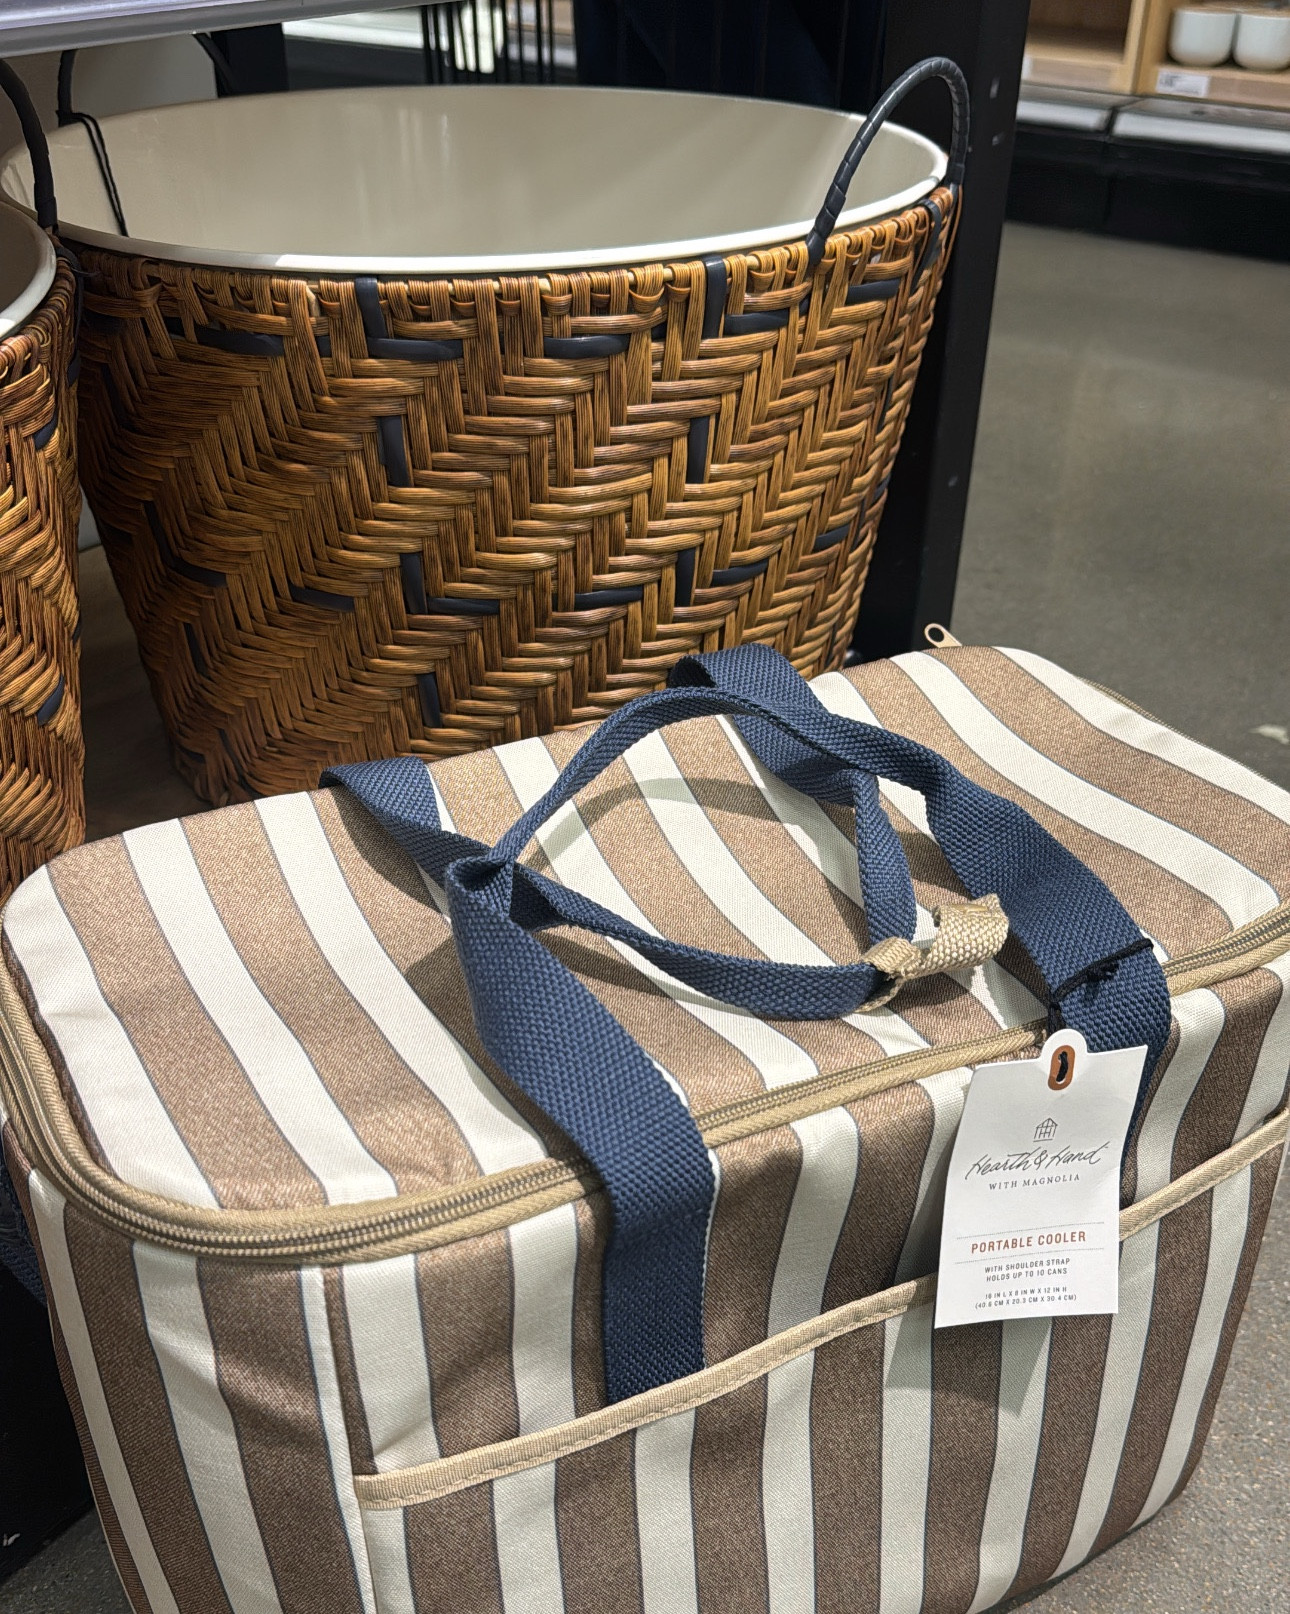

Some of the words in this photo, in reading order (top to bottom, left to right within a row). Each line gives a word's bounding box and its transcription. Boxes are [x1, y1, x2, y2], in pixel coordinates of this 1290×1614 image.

[964, 1146, 1041, 1180] Hearth
[1033, 1150, 1048, 1170] &
[1045, 1141, 1110, 1169] Hand
[989, 1180, 1018, 1190] WITH
[1022, 1173, 1080, 1187] MAGNOLIA
[971, 1236, 1033, 1254] PORTABLE
[1038, 1231, 1086, 1246] COOLER
[985, 1265, 1003, 1273] WITH
[1005, 1260, 1044, 1271] SHOULDER
[1046, 1257, 1070, 1266] STRAP
[986, 1273, 1010, 1282] HOLDS
[1013, 1271, 1023, 1279] UP
[1025, 1270, 1034, 1278] TO
[1047, 1267, 1068, 1276] CANS
